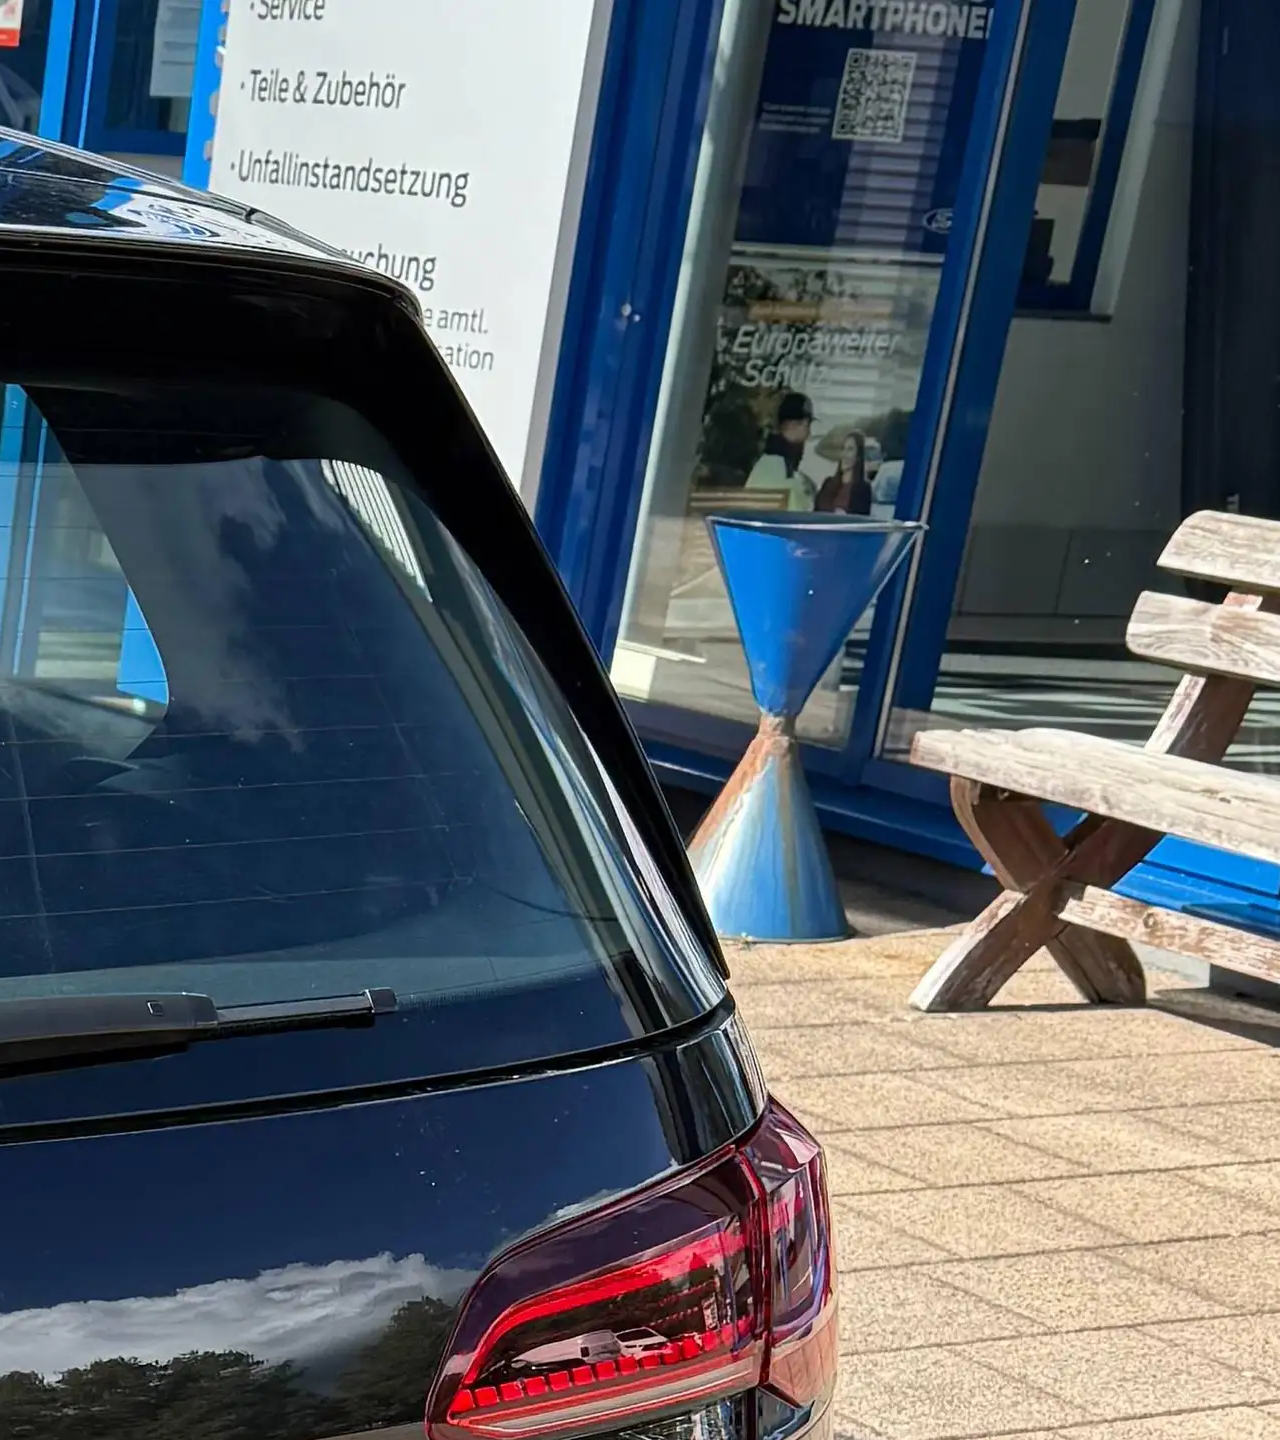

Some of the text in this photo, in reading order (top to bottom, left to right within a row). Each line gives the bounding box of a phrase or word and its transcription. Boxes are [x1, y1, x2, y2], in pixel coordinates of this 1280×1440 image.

[256, 0, 325, 21] Service
[250, 69, 407, 109] Teile & Zubehör
[238, 149, 470, 208] Unfallinstandsetzung
[437, 308, 489, 335] amtl.
